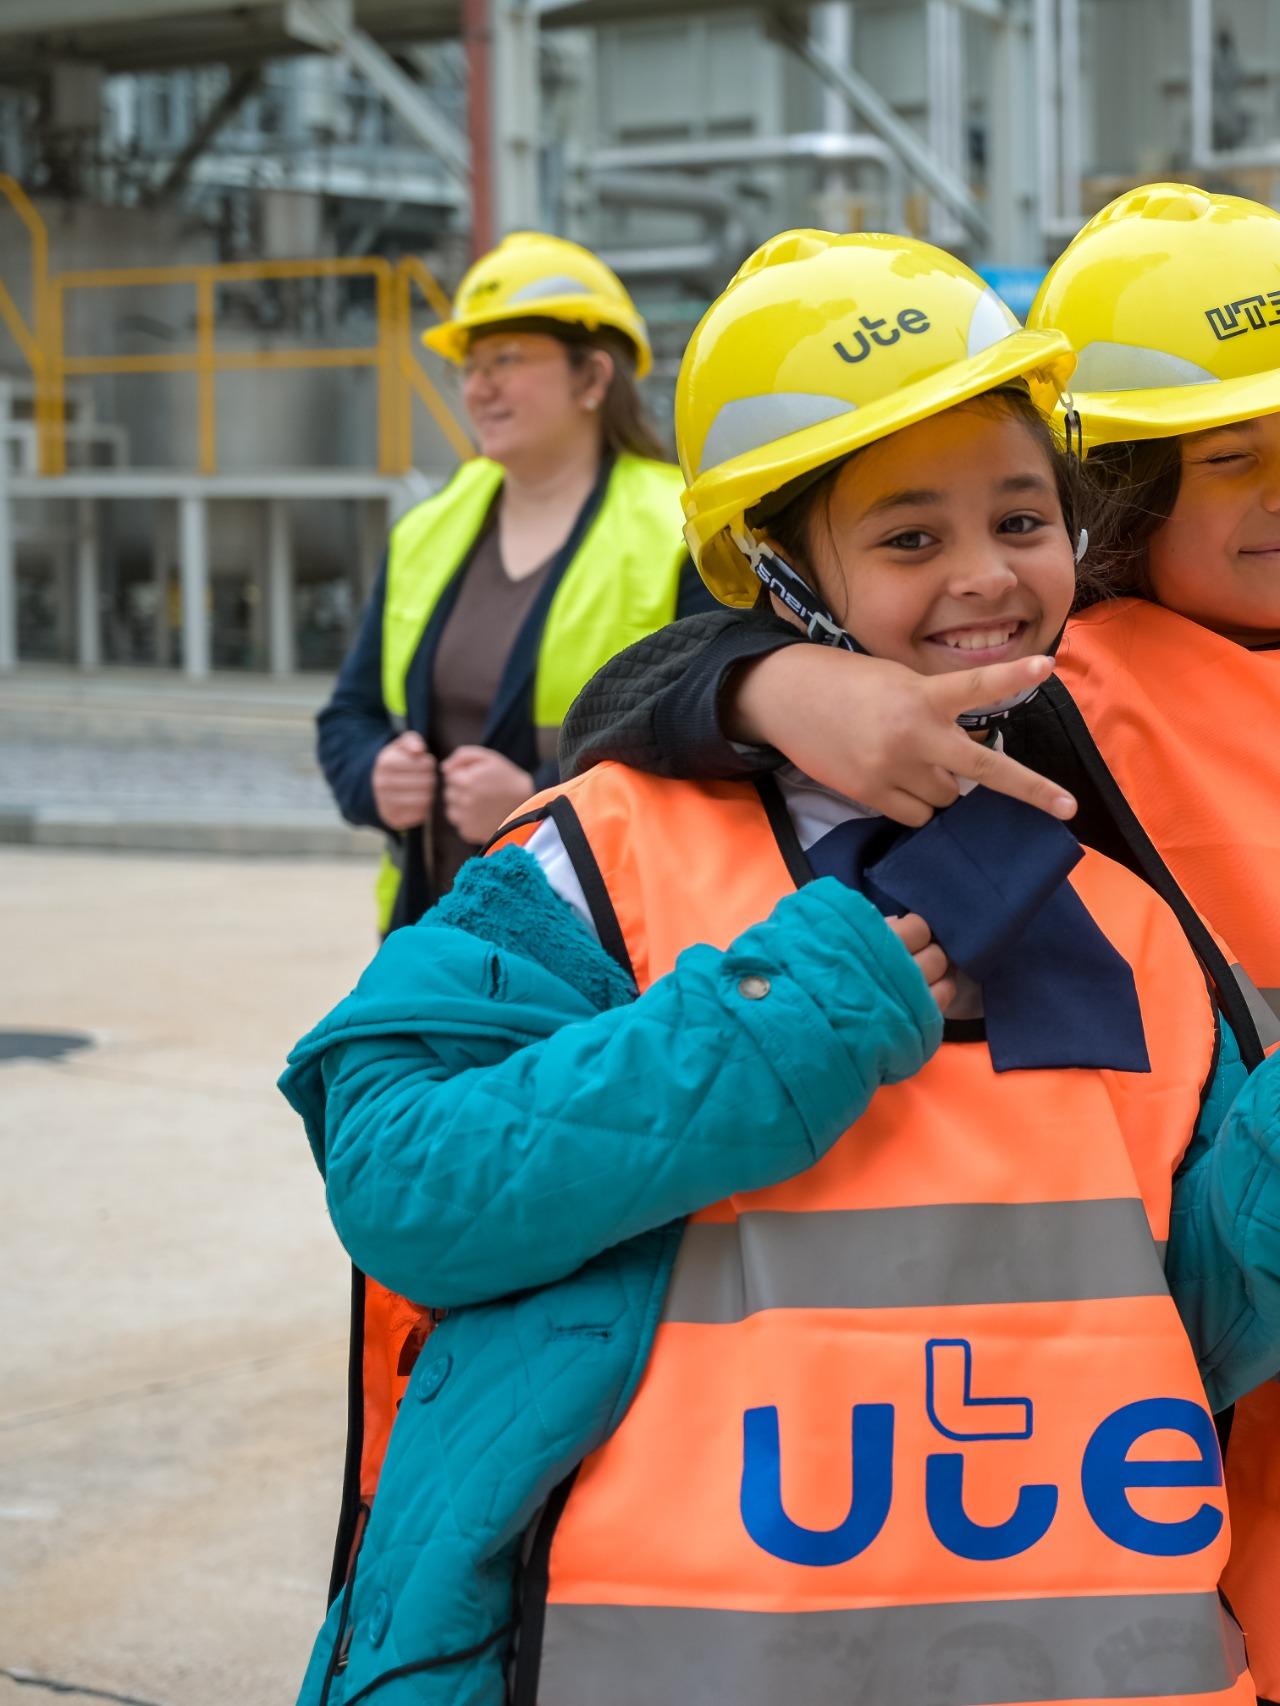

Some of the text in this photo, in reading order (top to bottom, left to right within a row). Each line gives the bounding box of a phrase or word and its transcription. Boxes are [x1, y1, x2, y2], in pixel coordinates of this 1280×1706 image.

[833, 308, 931, 364] ute
[756, 562, 813, 617] IBUS
[740, 1339, 1225, 1567] ute
